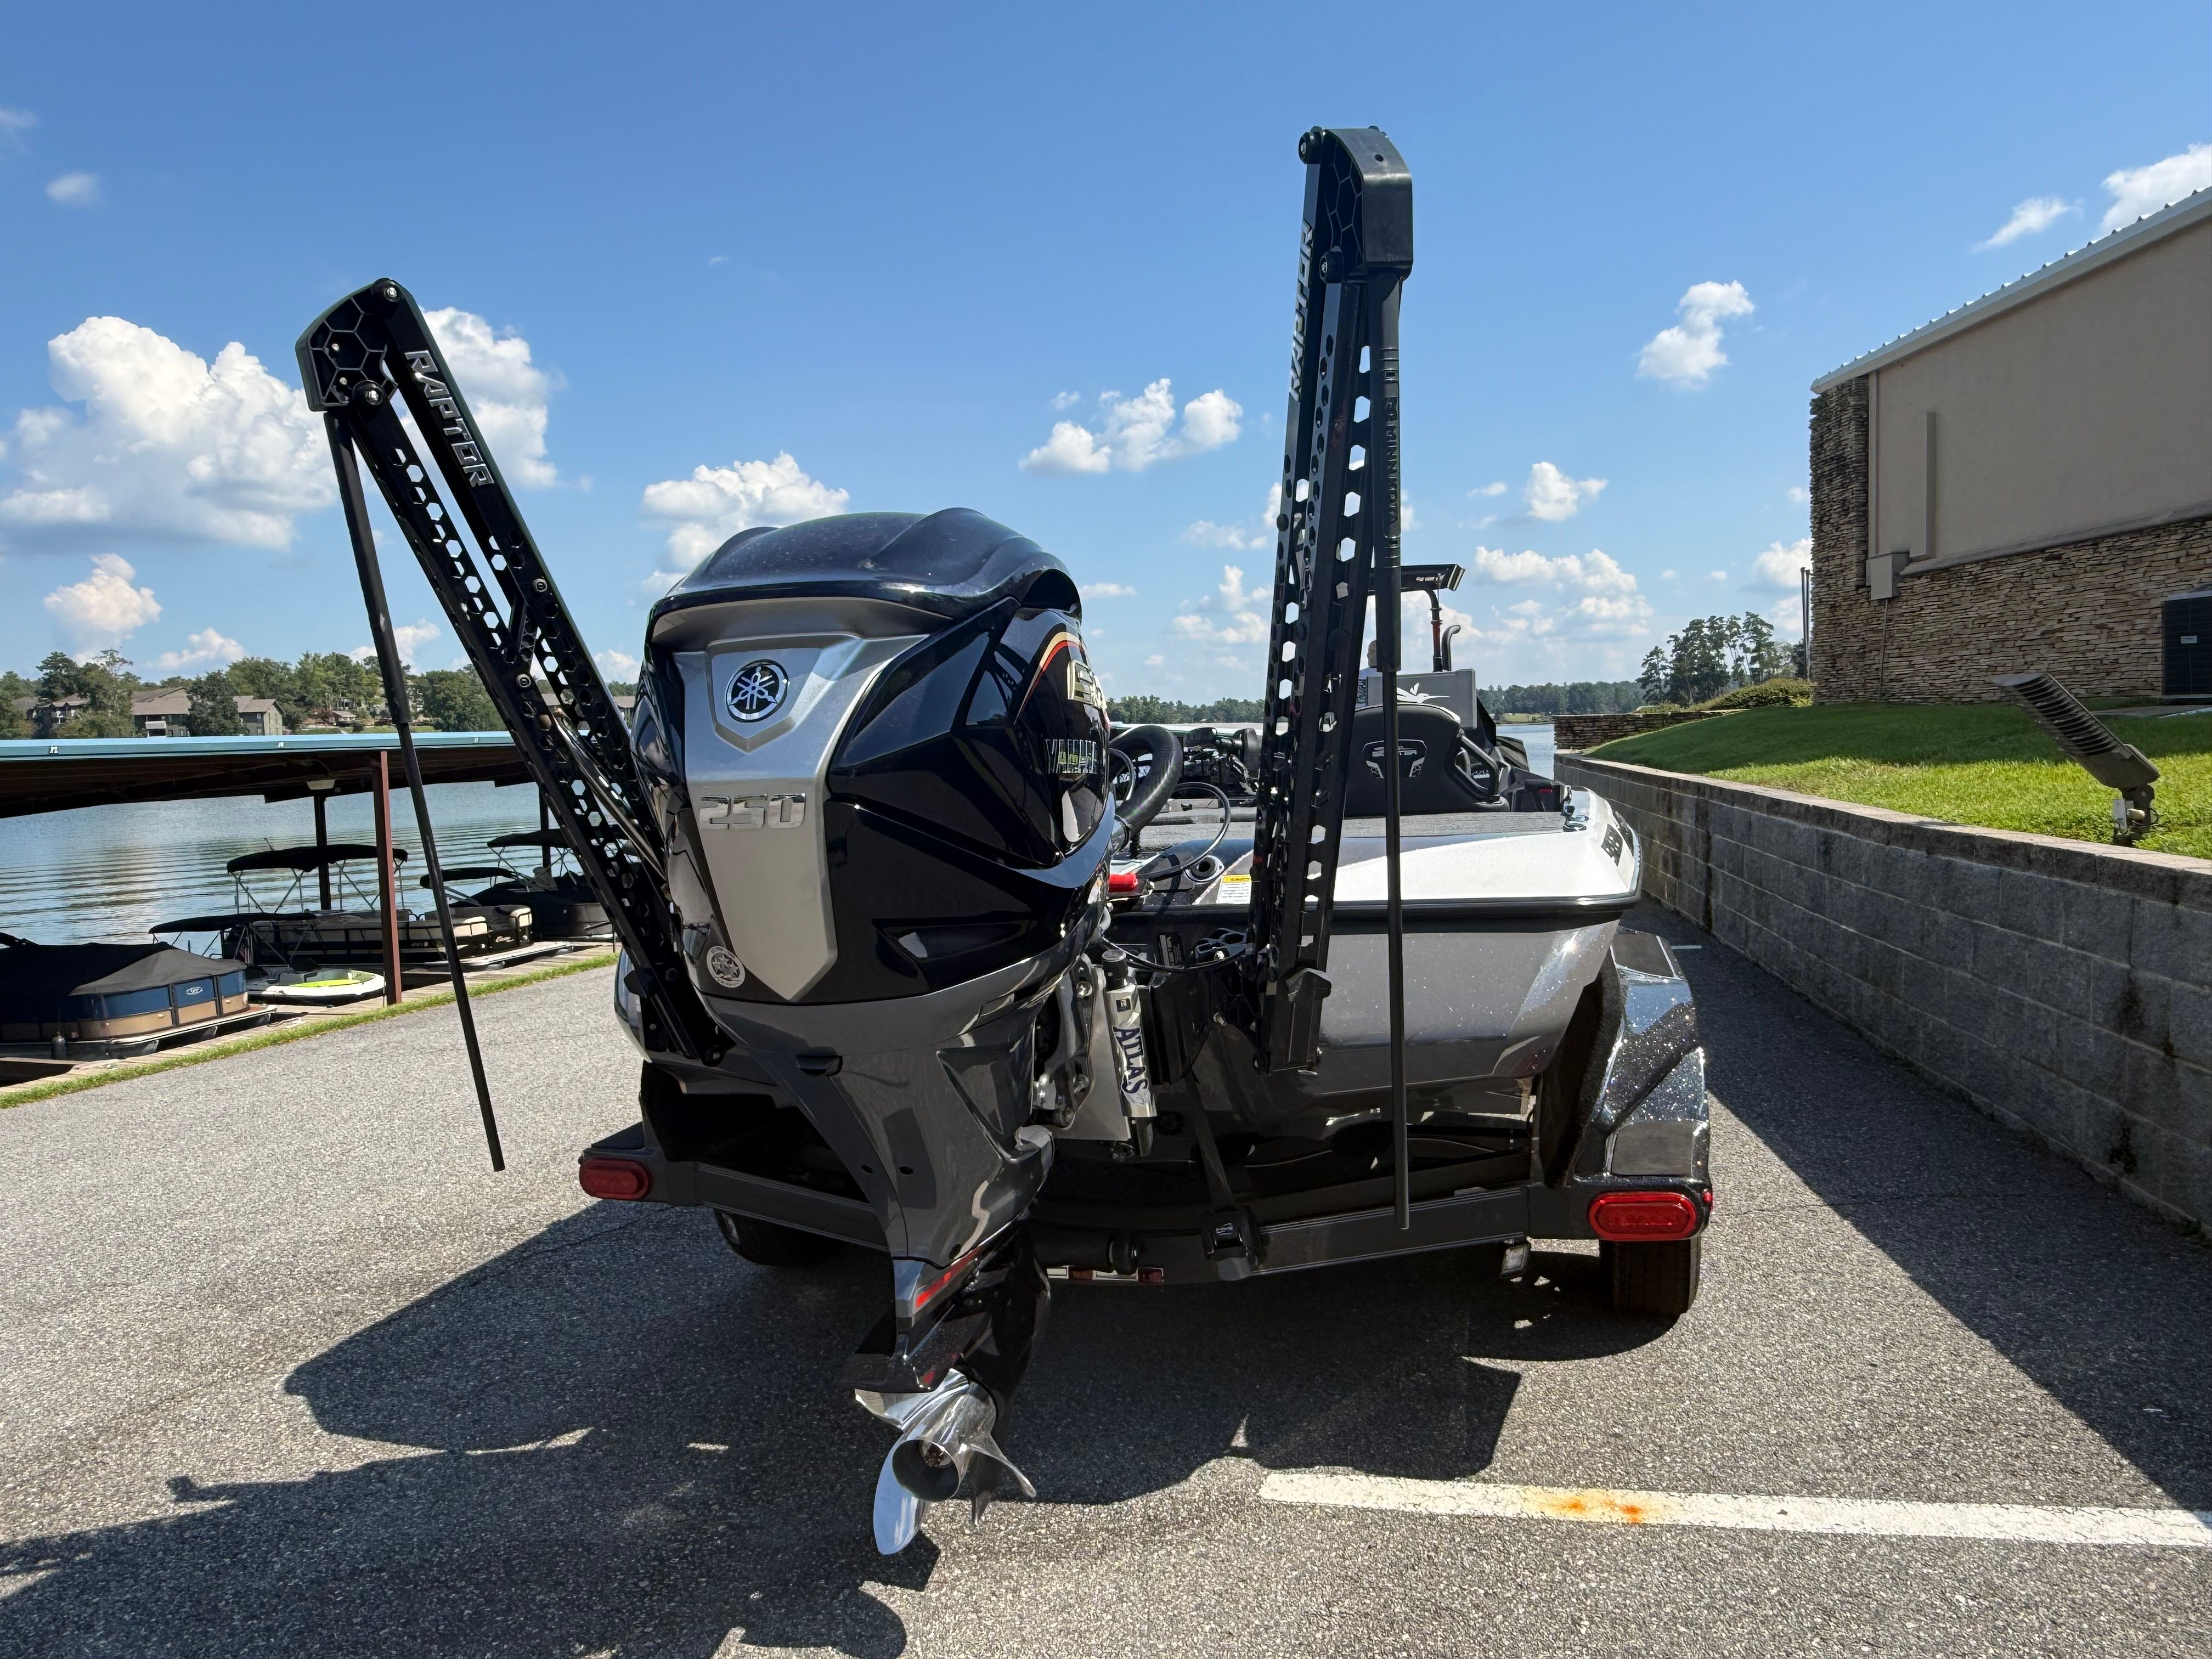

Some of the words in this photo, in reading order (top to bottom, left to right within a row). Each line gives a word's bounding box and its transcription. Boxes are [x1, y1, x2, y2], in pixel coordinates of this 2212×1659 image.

[1290, 221, 1313, 402] RAPTOR
[405, 350, 494, 488] RAPTOR
[699, 792, 806, 830] 250
[1114, 1026, 1148, 1094] ATLAS
